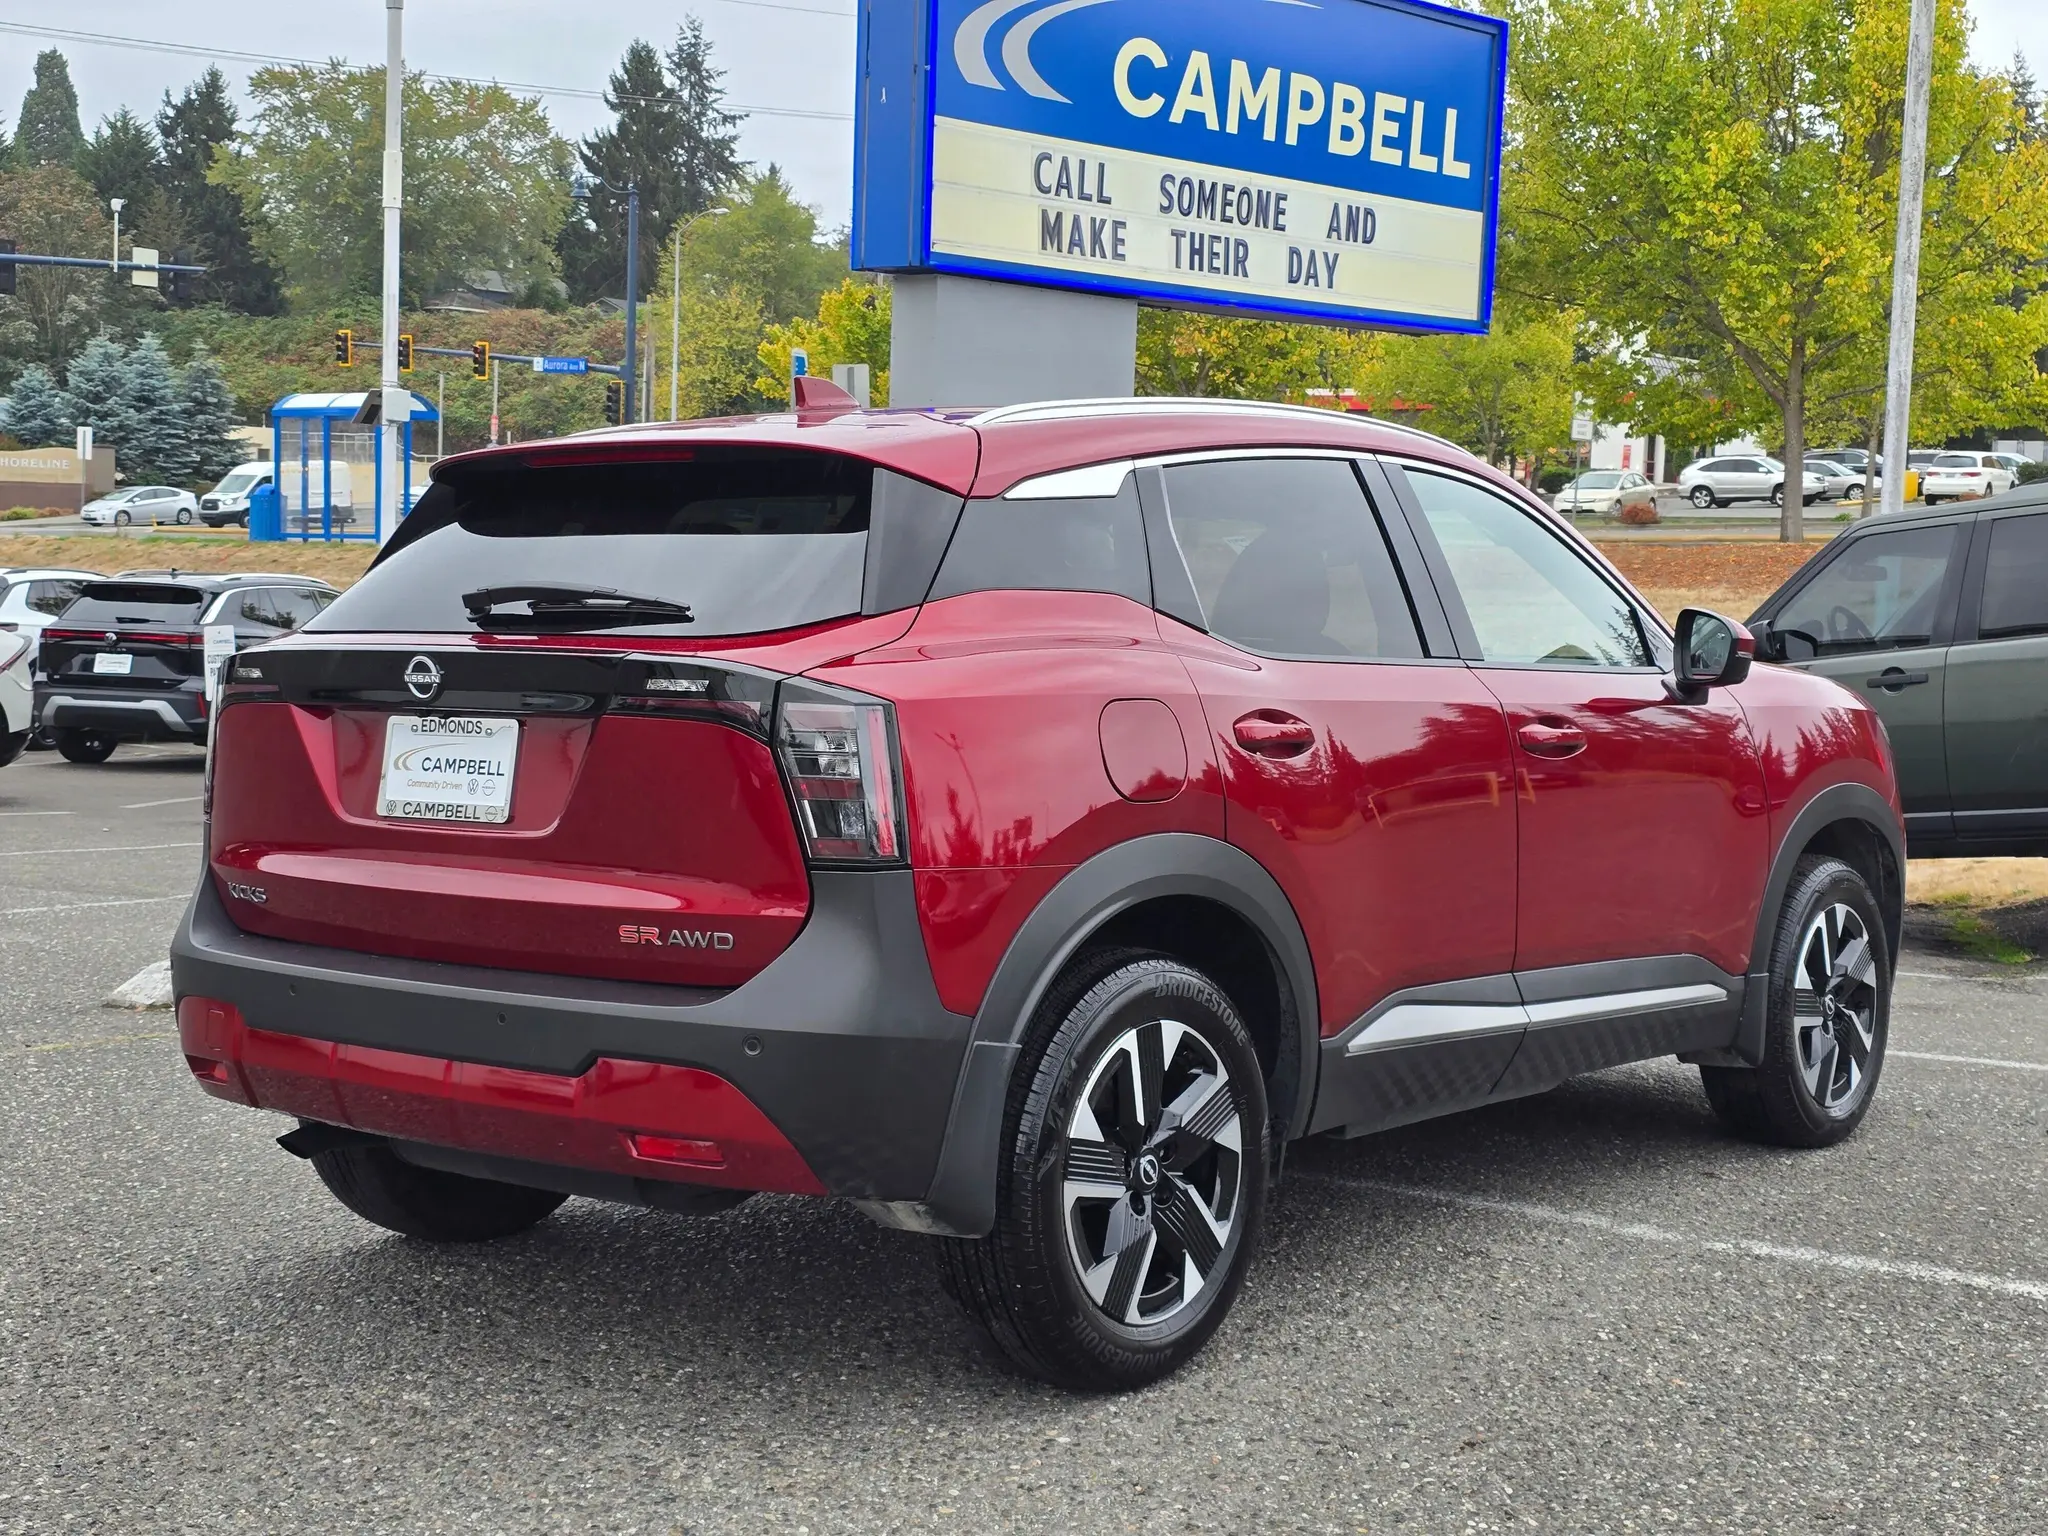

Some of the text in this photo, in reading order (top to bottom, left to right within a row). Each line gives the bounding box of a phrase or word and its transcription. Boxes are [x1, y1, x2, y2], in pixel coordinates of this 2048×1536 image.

[1113, 37, 1471, 179] CAMPBELL
[1034, 152, 1376, 244] CALL SOMEONE AND
[1041, 209, 1339, 289] MAKE THEIR DAY
[544, 360, 568, 370] Aurora
[579, 360, 586, 371] N
[404, 674, 440, 683] NISSAN
[421, 718, 483, 735] EDMONDS
[421, 757, 505, 777] CAMPBELL
[406, 778, 463, 791] Community Driven
[402, 801, 481, 820] CAMPBELL
[227, 882, 267, 903] KICKS
[618, 924, 734, 950] SR AWD
[1154, 973, 1248, 1047] BRIDGESTONE
